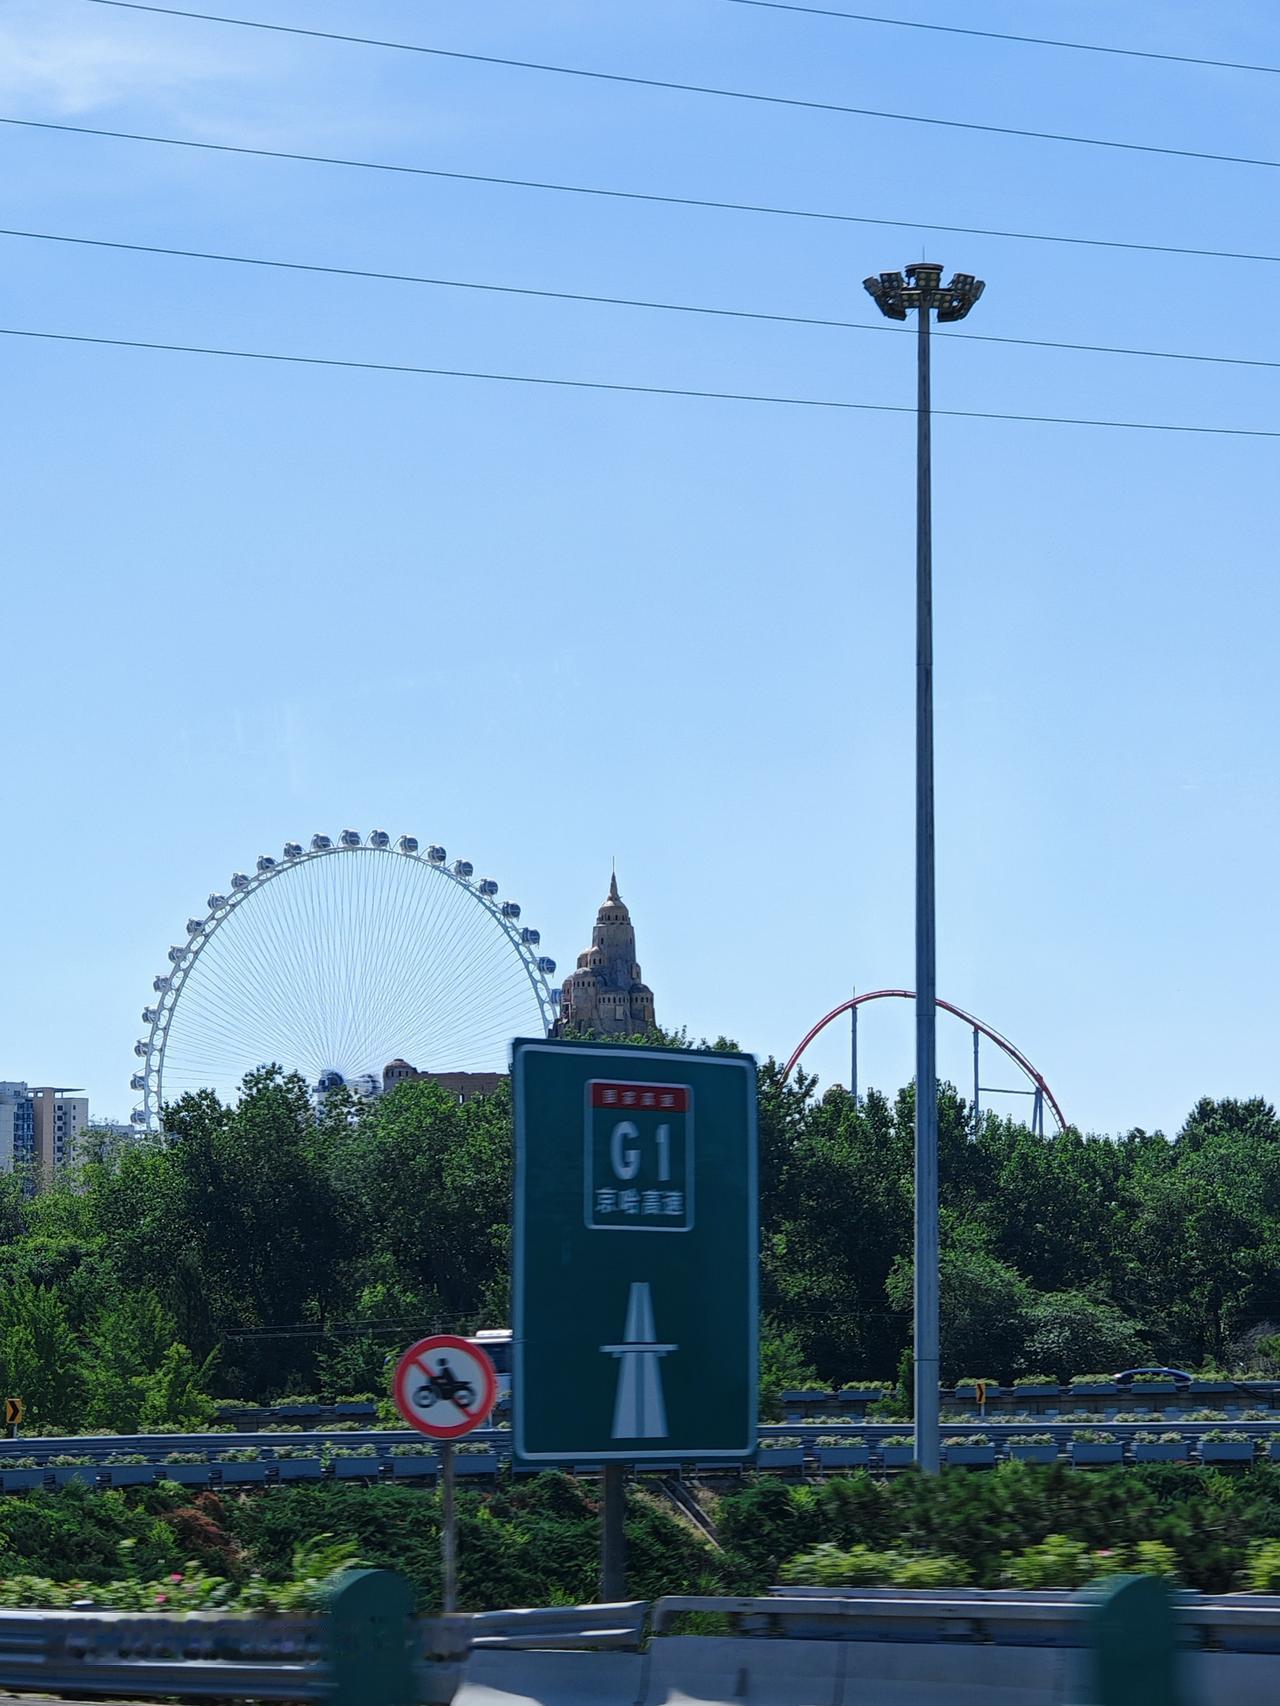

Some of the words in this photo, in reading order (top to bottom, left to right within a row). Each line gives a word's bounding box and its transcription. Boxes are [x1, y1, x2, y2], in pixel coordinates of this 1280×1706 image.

[611, 1121, 671, 1181] G1
[595, 1187, 684, 1216] 京哈高速
